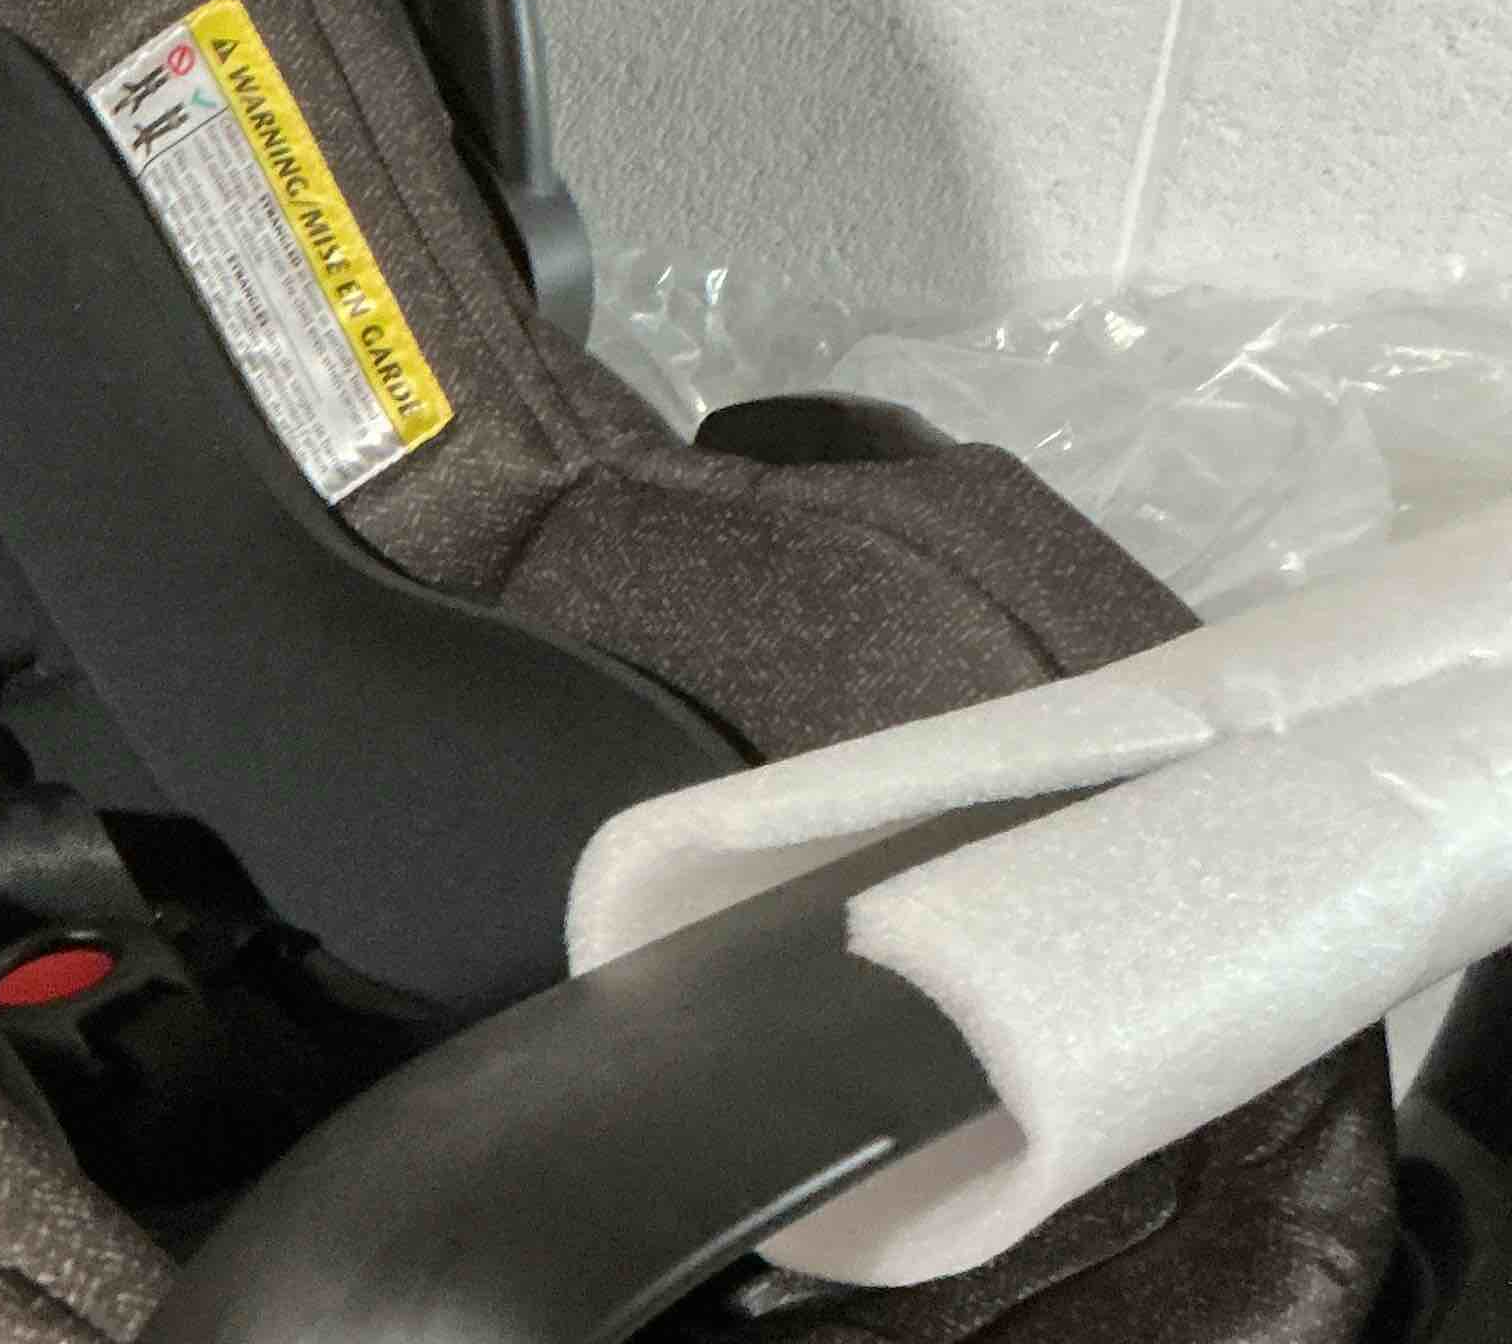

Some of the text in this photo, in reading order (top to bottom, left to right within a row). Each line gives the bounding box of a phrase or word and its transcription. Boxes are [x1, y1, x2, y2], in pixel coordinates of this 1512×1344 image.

[228, 64, 350, 274] WARNING/MISE
[335, 279, 377, 319] EN
[361, 323, 425, 417] GARDE
